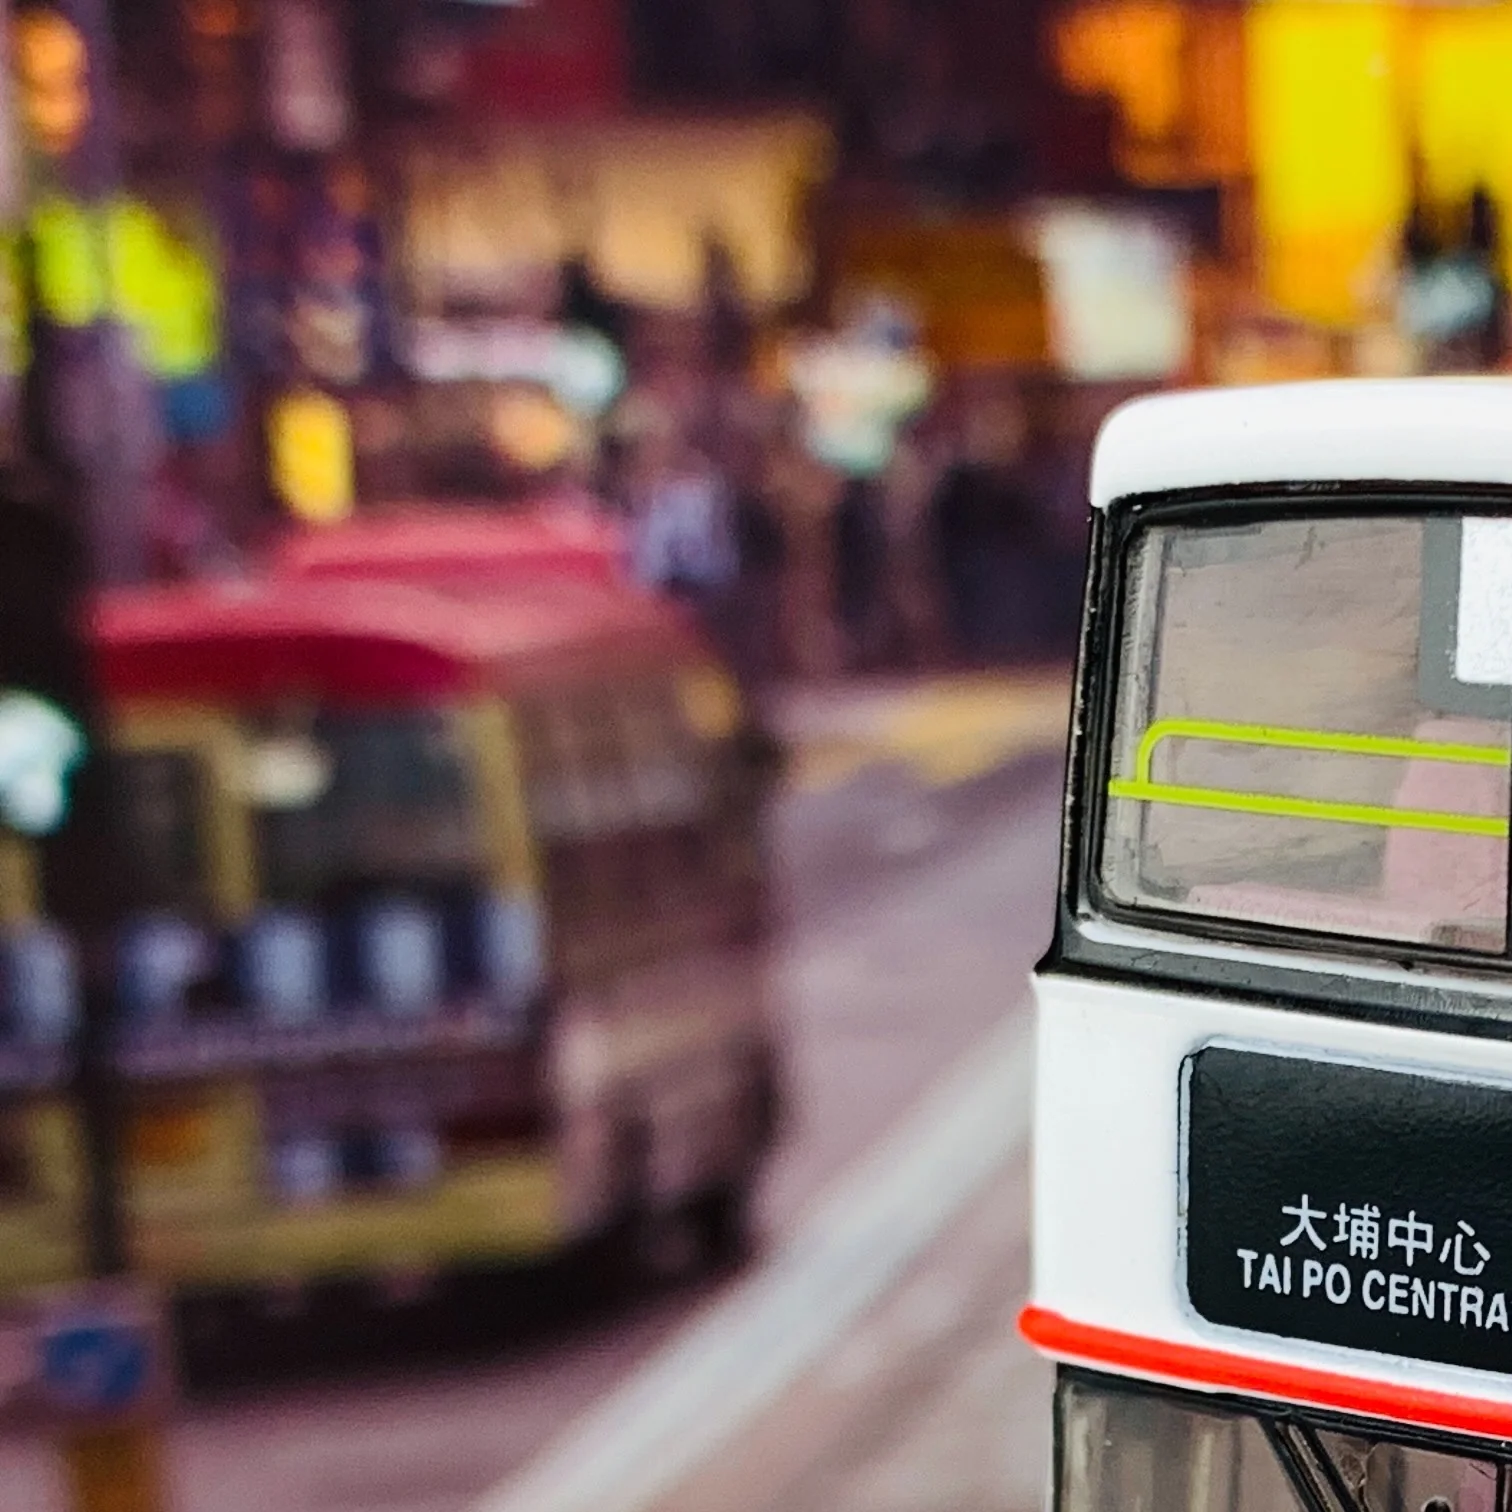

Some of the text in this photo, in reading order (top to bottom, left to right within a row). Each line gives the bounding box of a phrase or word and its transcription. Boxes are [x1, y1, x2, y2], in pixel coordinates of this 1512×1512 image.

[1279, 1194, 1492, 1276] 大埔中心
[1236, 1248, 1292, 1296] TAI
[1302, 1262, 1351, 1306] PO
